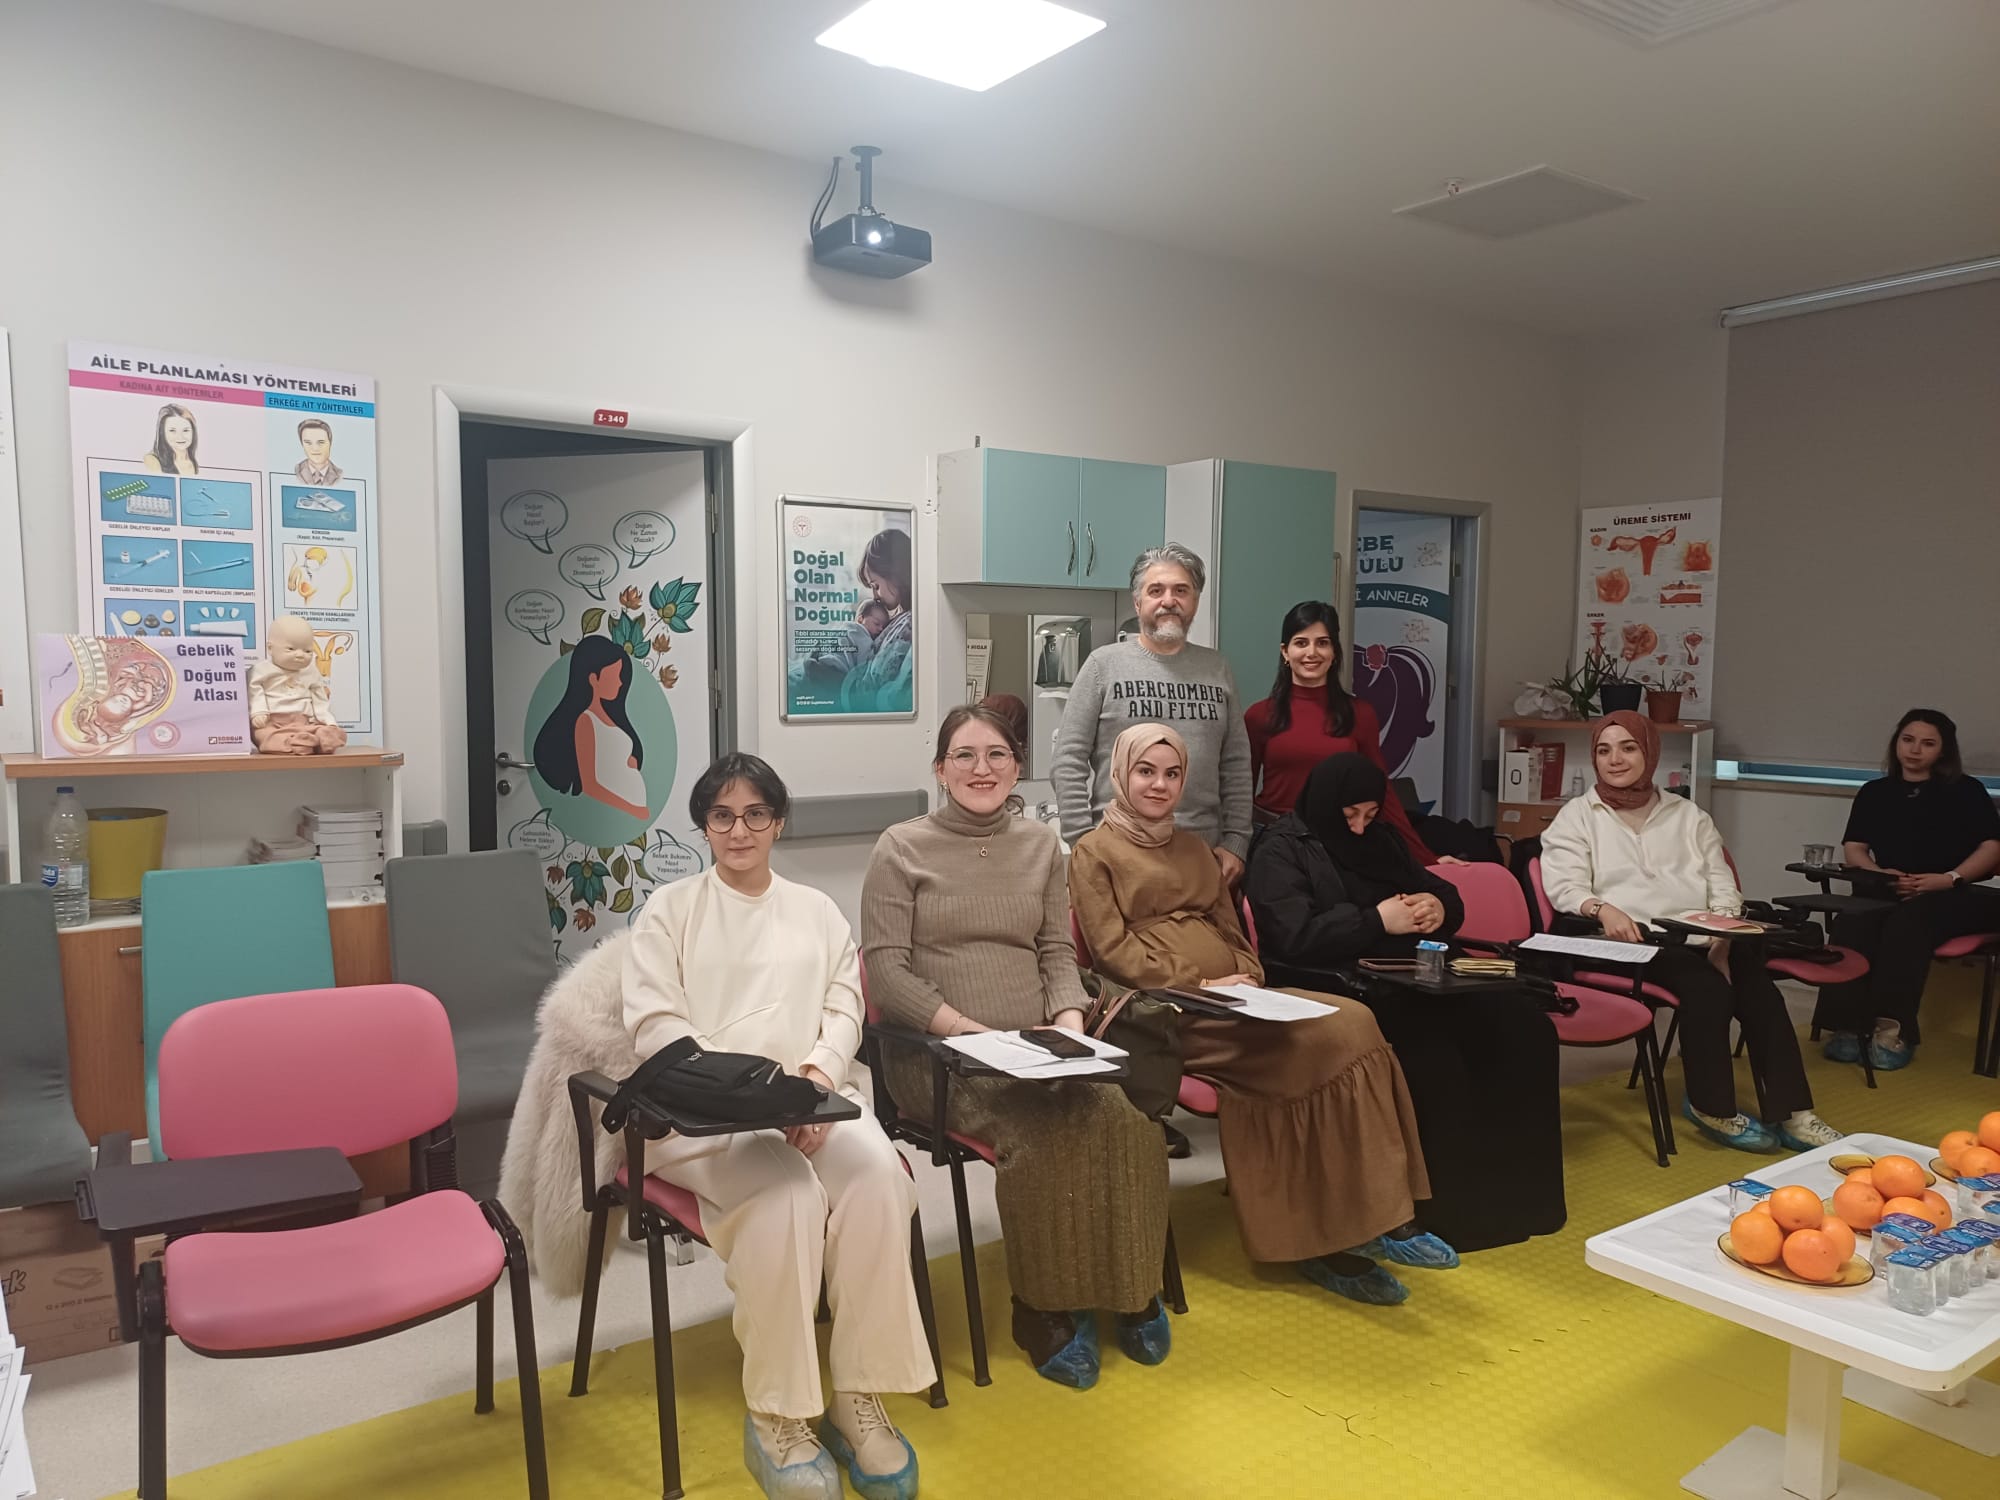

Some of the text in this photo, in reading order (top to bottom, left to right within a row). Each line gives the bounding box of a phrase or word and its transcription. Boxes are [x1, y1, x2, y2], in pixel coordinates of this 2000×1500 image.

[91, 354, 357, 397] AİLE PLANLAMASI YÖNTEMLERİ
[119, 380, 152, 391] KADINA
[316, 400, 364, 414] YÖNTEMLER
[1613, 514, 1648, 526] ÜREME
[793, 550, 844, 569] Doğal
[793, 568, 835, 585] Olan
[794, 587, 858, 604] Normal
[1367, 590, 1429, 607] ANNELER
[794, 606, 857, 625] Doğum
[176, 644, 235, 656] Gebelik
[183, 669, 237, 684] Doğum
[194, 688, 238, 701] Atlası
[1113, 680, 1224, 703] ABERCROMBIE
[1128, 700, 1219, 720] AND FITCH
